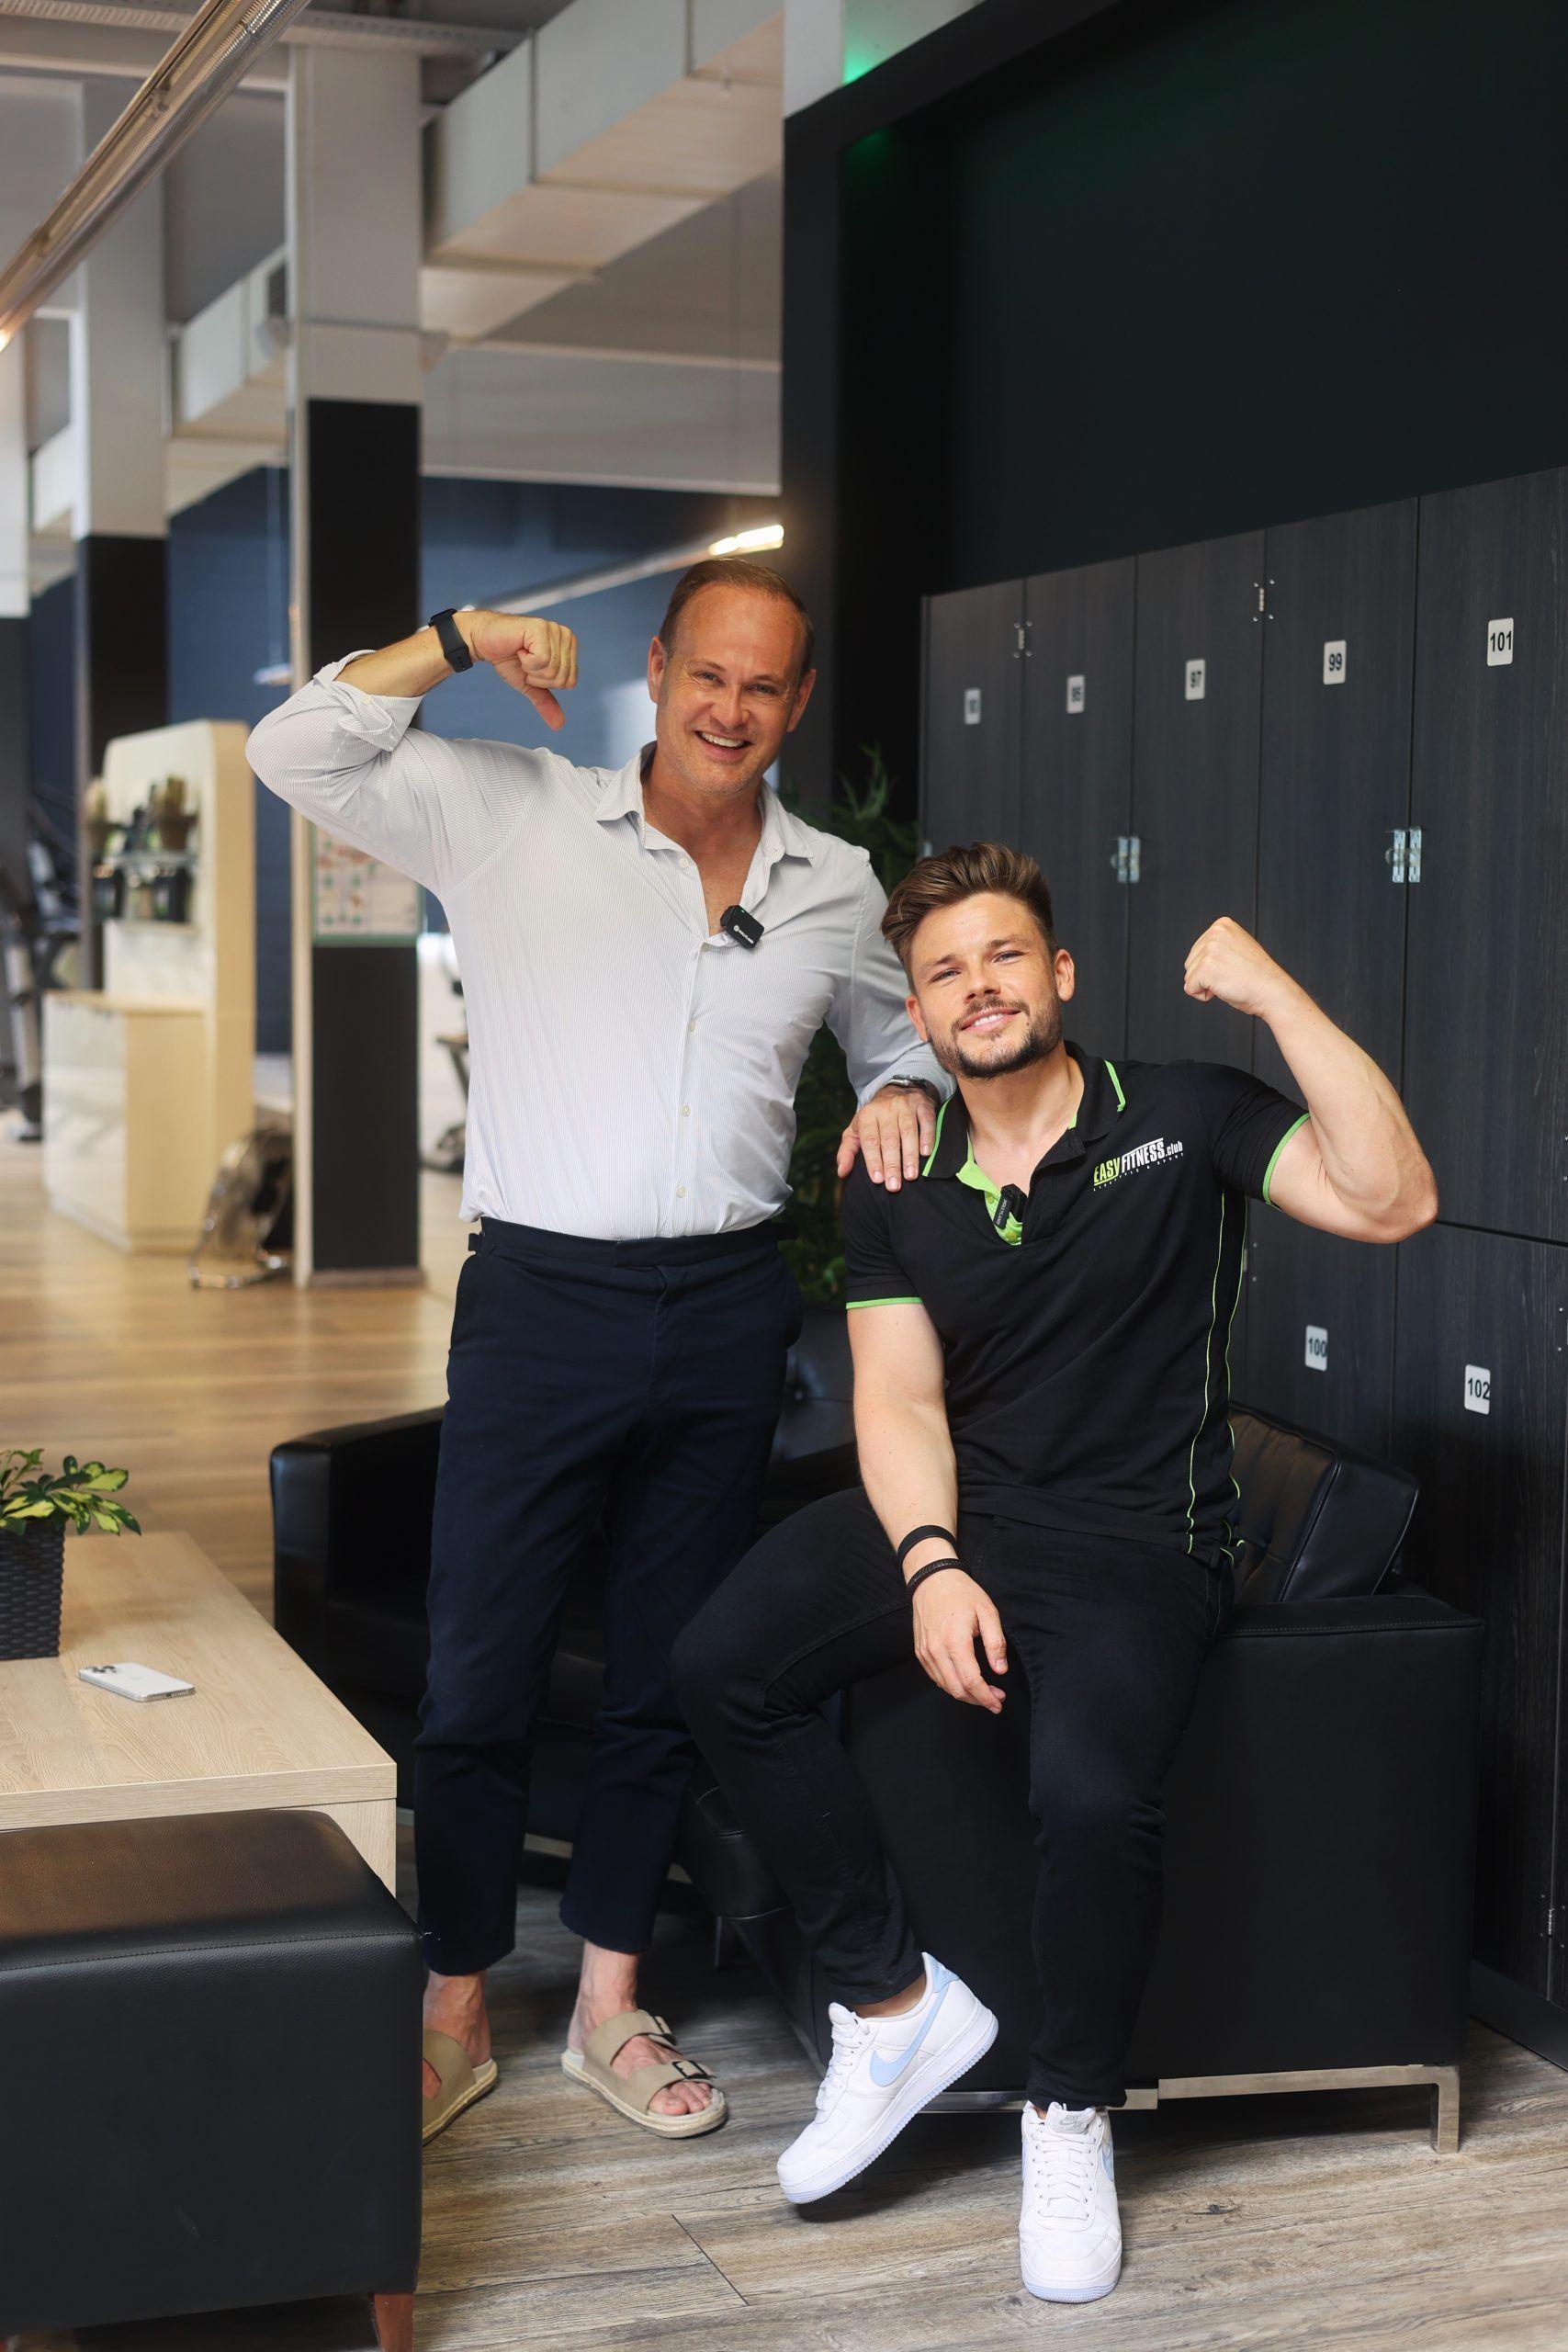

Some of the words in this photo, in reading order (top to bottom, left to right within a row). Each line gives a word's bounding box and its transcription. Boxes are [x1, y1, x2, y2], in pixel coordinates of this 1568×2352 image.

[1490, 630, 1512, 652] 101
[1328, 652, 1343, 673] 99
[1308, 1337, 1328, 1358] 100
[1468, 1377, 1491, 1400] 102
